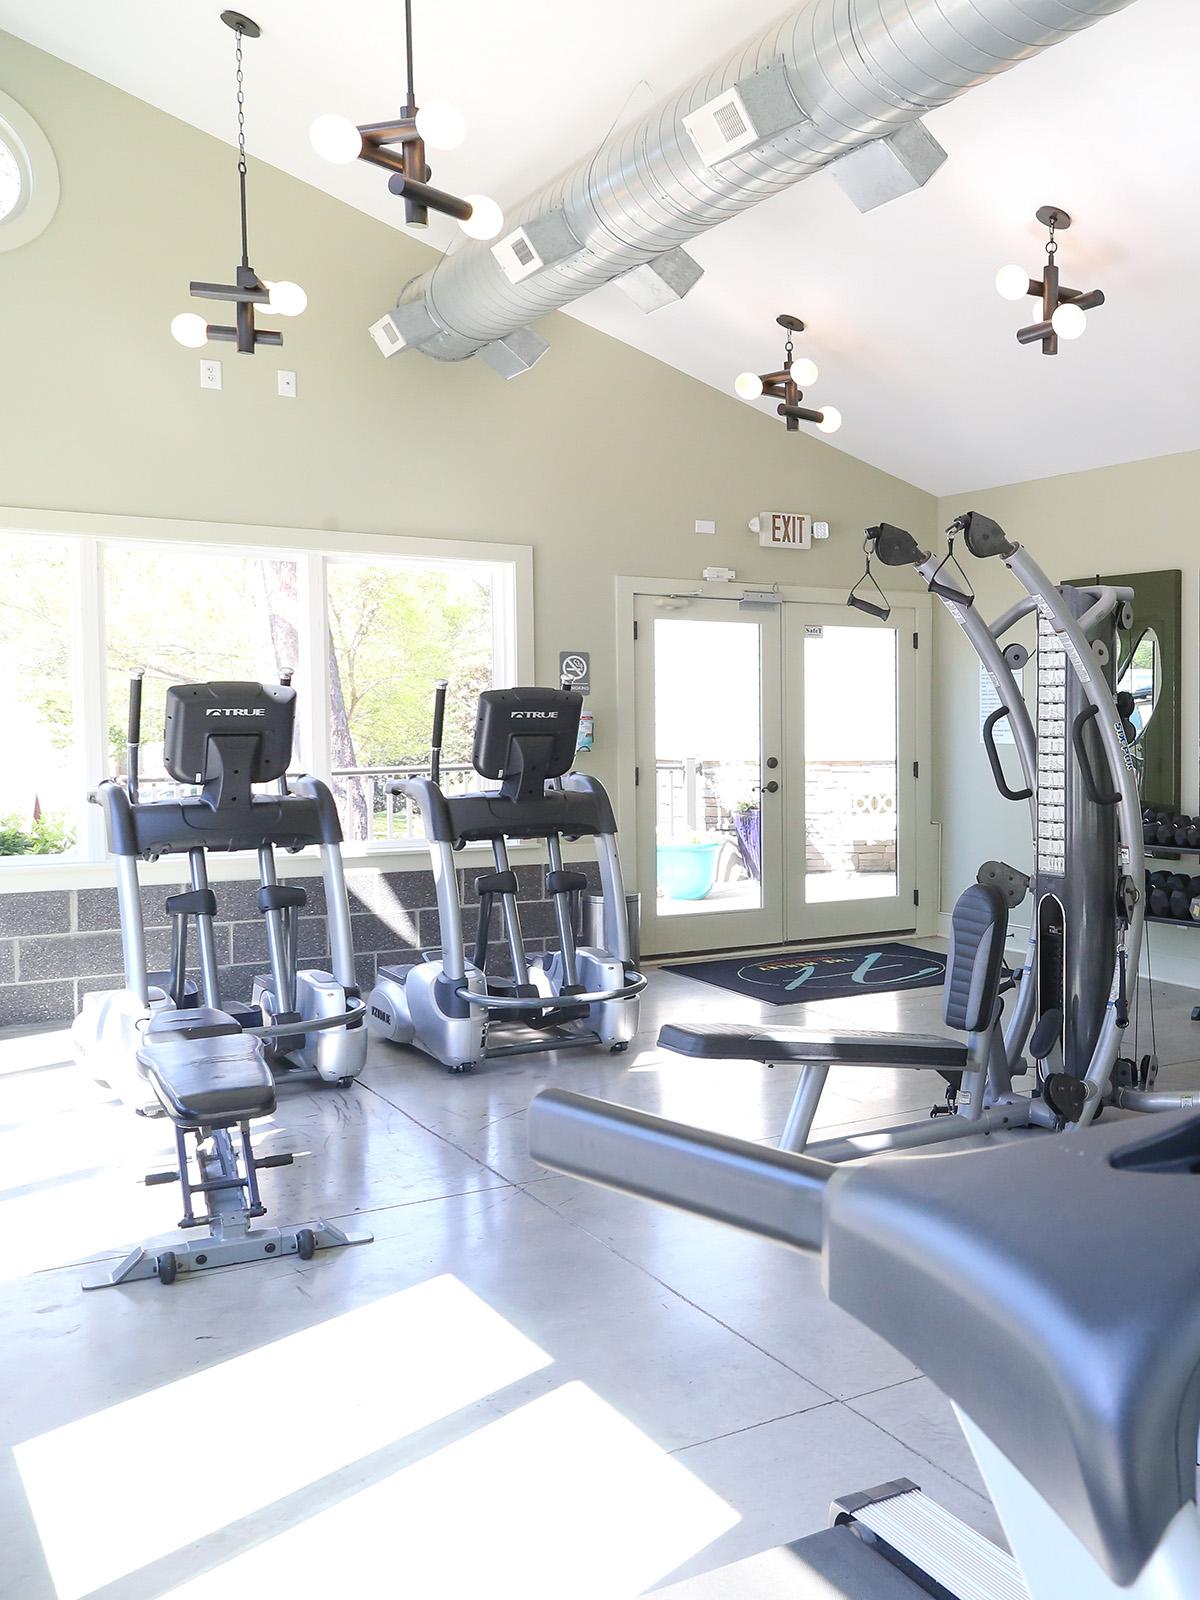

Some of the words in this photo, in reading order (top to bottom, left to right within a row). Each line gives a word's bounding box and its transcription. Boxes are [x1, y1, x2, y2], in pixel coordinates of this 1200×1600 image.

[772, 515, 805, 543] EXIT
[222, 708, 265, 716] TRUE
[524, 711, 559, 719] TRUE
